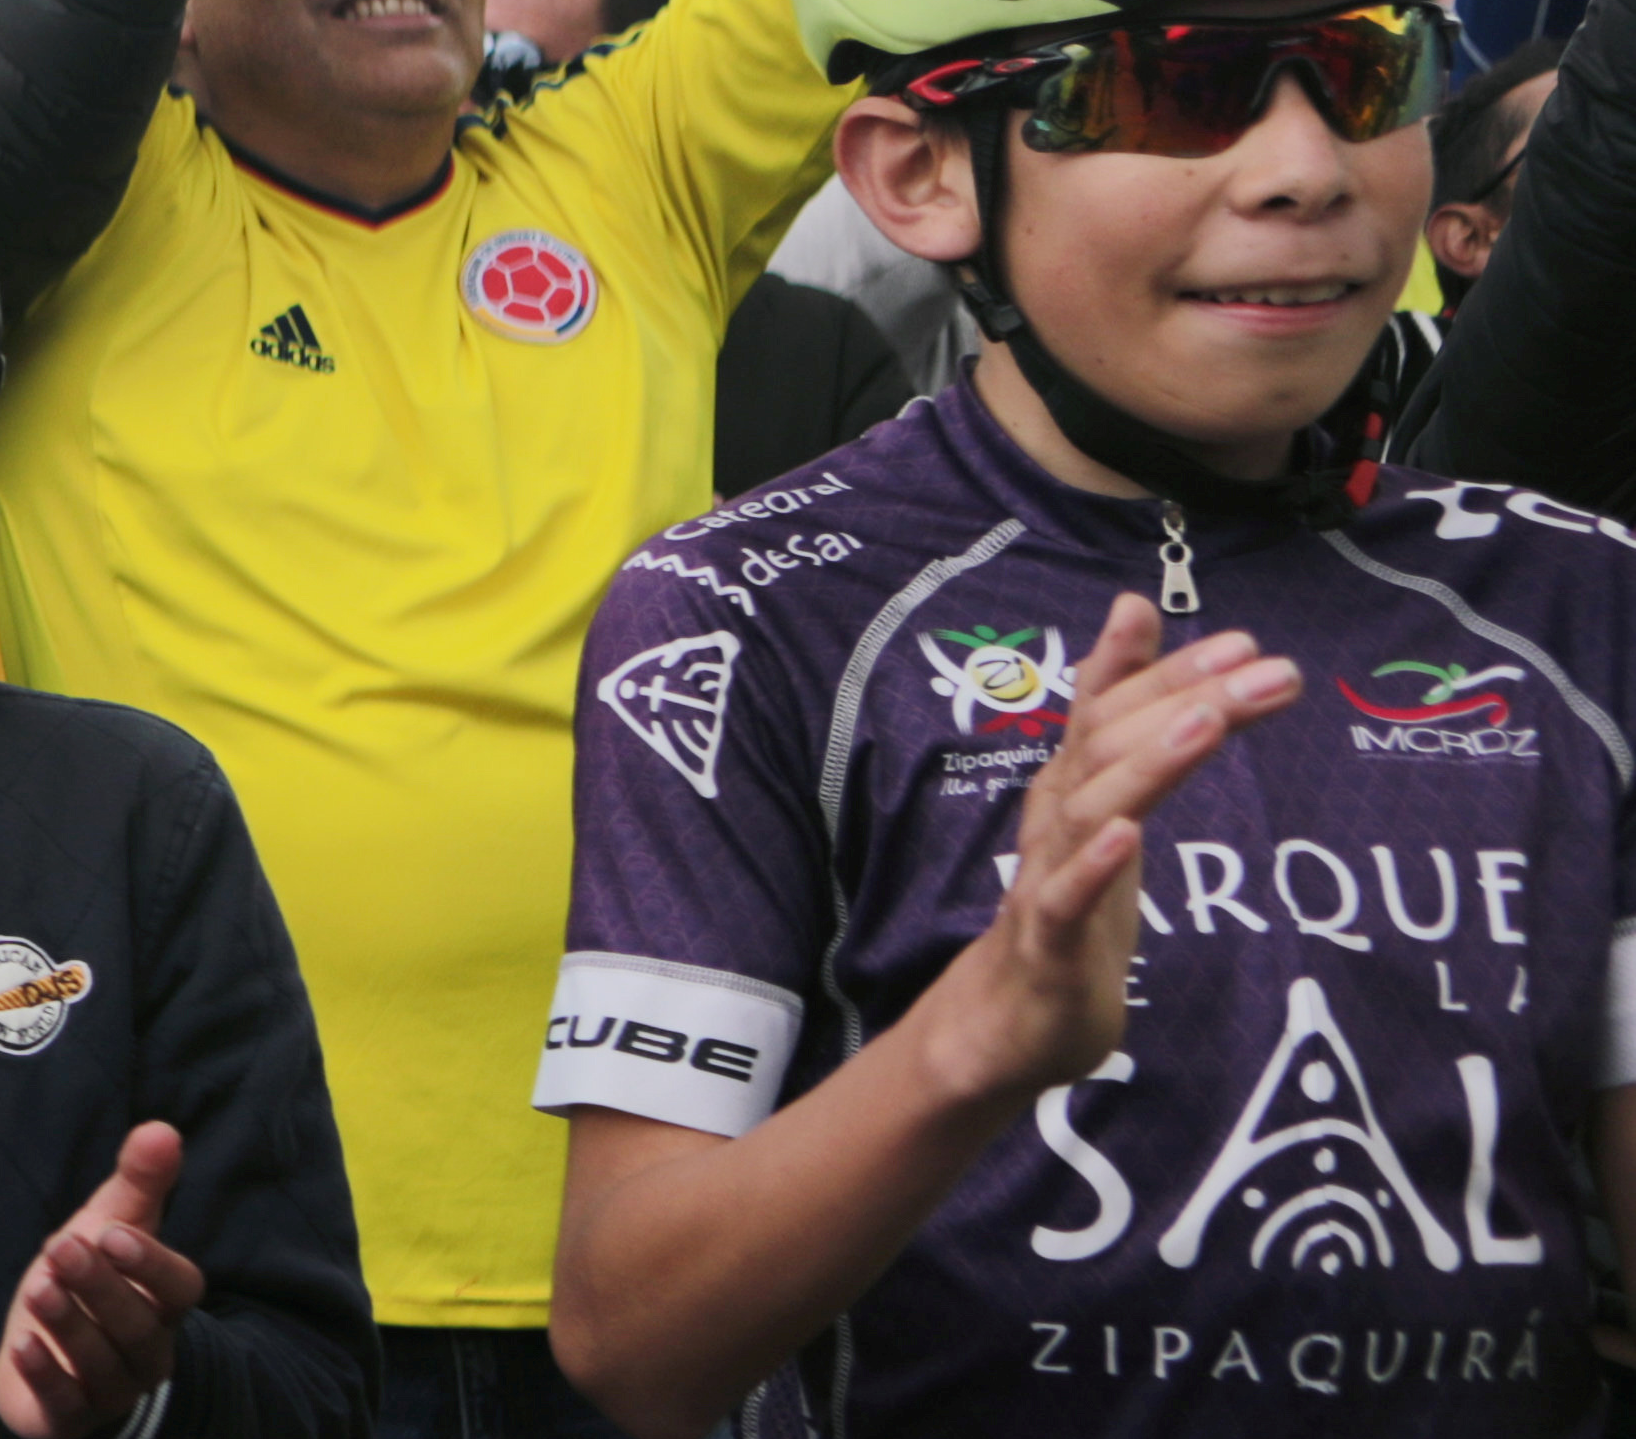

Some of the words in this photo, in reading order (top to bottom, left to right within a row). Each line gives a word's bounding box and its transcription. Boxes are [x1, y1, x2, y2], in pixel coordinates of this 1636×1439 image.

[250, 338, 335, 374] adidas
[741, 547, 800, 586] de
[942, 742, 1049, 774] Zipaquirá
[1350, 723, 1539, 759] IMCRDZ
[545, 1014, 760, 1084] CUBE
[1030, 976, 1542, 1273] SAL
[1030, 1309, 1544, 1394] ZIPAQUIRÁ
